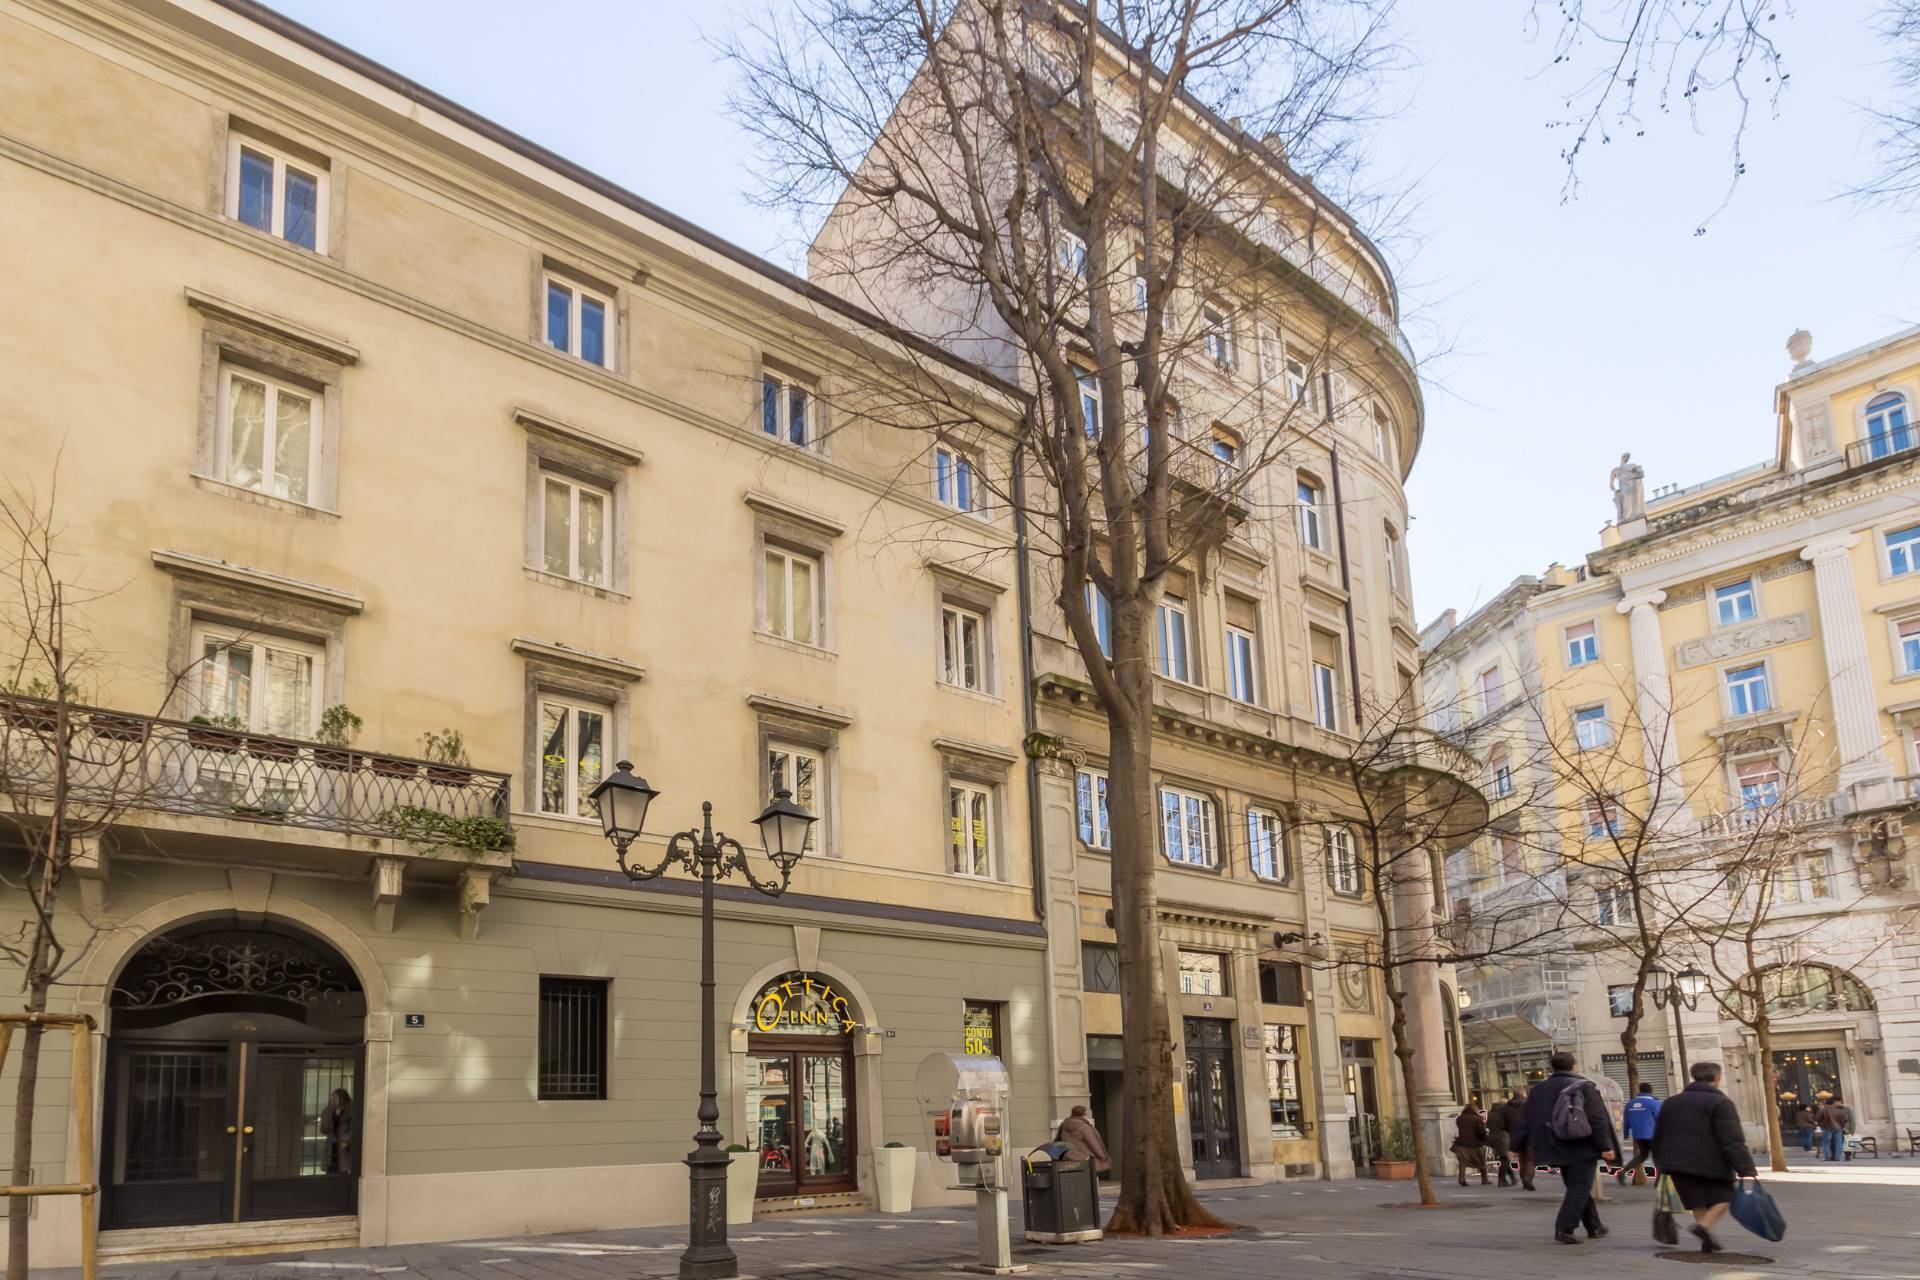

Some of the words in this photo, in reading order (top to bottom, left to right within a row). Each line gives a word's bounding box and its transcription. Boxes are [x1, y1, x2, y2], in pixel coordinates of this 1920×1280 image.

[757, 979, 856, 1033] OTTICA
[412, 1016, 418, 1024] 5
[790, 1009, 828, 1025] INN
[964, 1026, 993, 1038] CONTO
[965, 1037, 992, 1056] 50%
